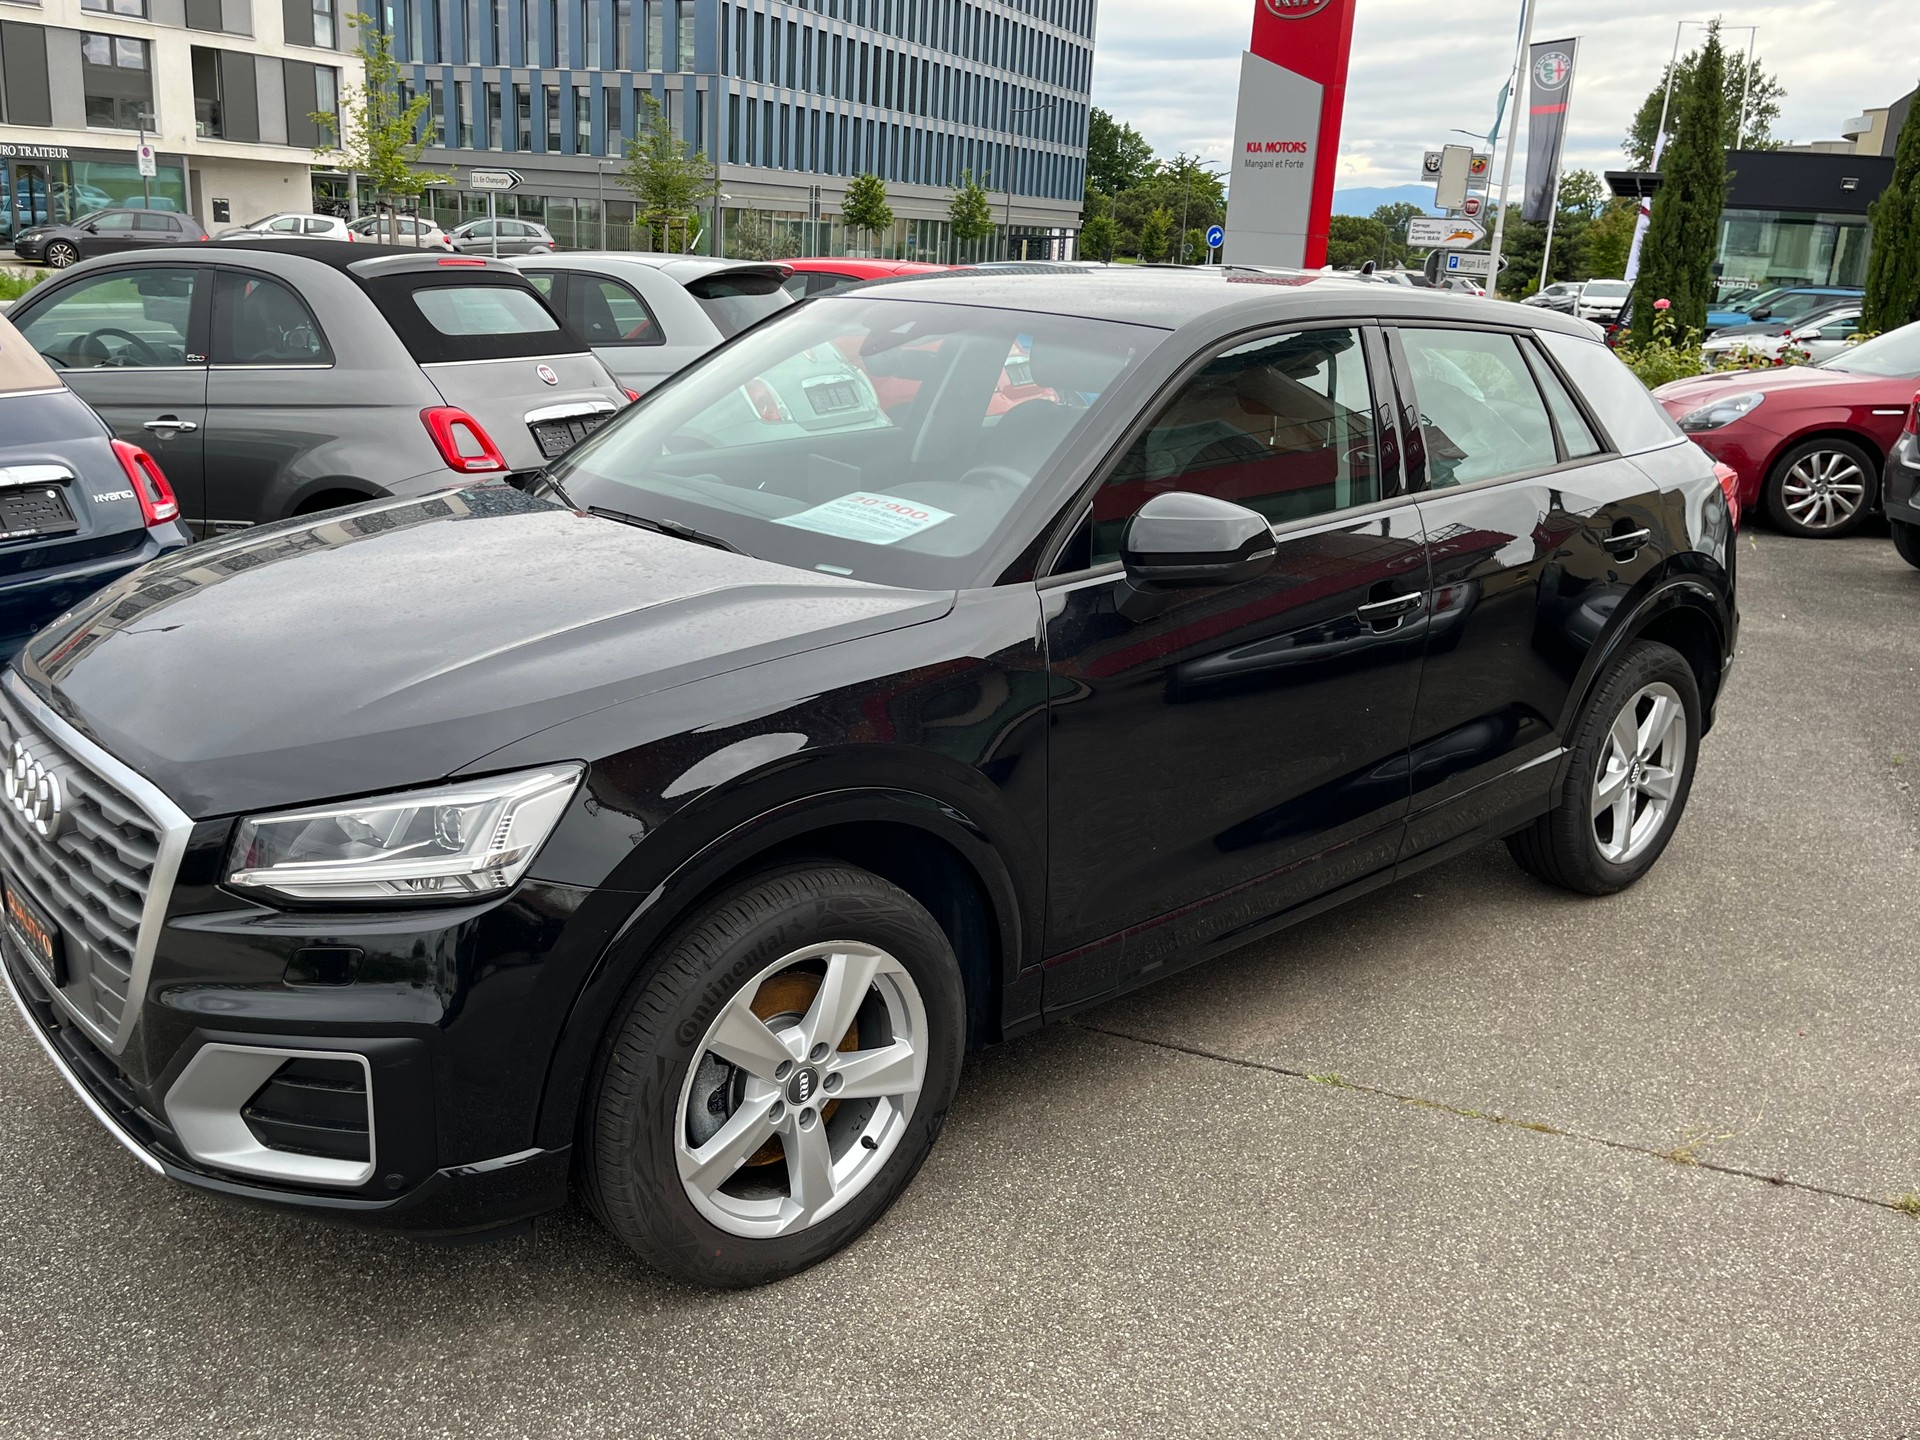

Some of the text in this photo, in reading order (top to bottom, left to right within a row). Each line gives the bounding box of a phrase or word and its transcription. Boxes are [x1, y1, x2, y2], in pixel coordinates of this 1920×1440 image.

[0, 145, 69, 159] RO TRAITEUR
[1246, 142, 1307, 153] KIA MOTORS
[1245, 159, 1304, 169] Mangani et Forte
[92, 489, 135, 503] HYBRID
[674, 925, 787, 1048] Continental
